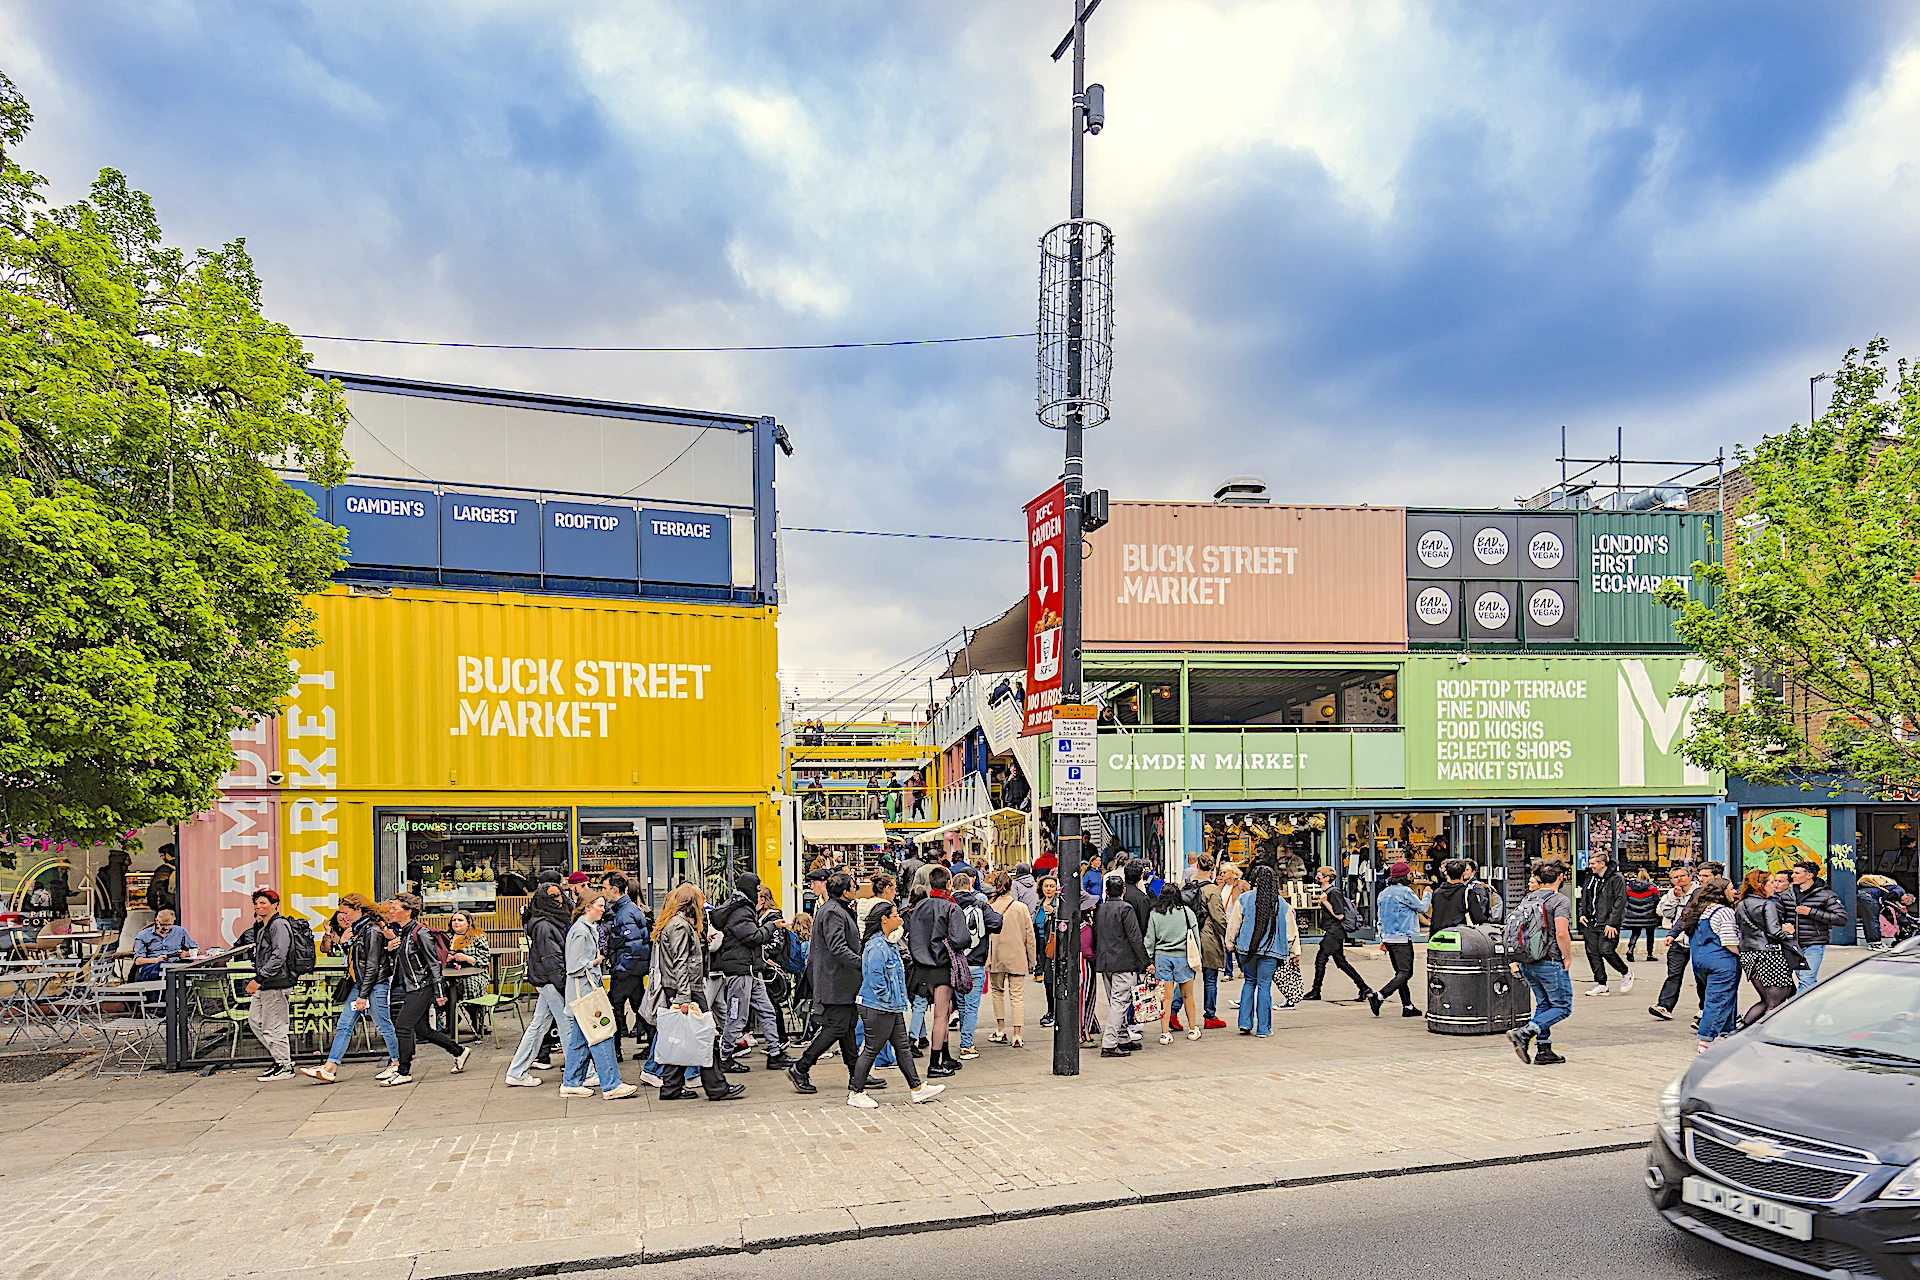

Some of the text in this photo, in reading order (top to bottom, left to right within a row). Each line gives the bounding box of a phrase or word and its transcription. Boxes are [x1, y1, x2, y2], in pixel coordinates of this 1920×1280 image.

[346, 497, 711, 539] CAMDEN'S LARGEST ROOFTOP TERRACE
[1036, 501, 1053, 523] KFC
[1032, 515, 1061, 548] CAMDEN
[1421, 539, 1444, 551] BAD
[1477, 536, 1500, 548] BAD
[1477, 547, 1505, 555] VEGAN
[1532, 540, 1555, 552] BAD
[1591, 534, 1669, 554] LONDON'S
[1122, 544, 1298, 575] BUCK STREET
[1421, 550, 1449, 558] VEGAN
[1532, 551, 1560, 559] VEGAN
[1591, 554, 1636, 573] FIRST
[1420, 595, 1442, 607] BAD
[1478, 600, 1500, 612] BAD
[1532, 597, 1555, 609] BAD
[1420, 606, 1448, 615] VEGAN
[1478, 611, 1506, 619] VEGAN
[1532, 608, 1560, 616] VEGAN
[458, 656, 711, 700] BUCK STREET
[1040, 663, 1053, 675] KFC
[1437, 680, 1587, 699] ROOFTOP TERRACE
[1027, 687, 1062, 711] 100 YARDS
[1437, 700, 1531, 719] FINE DINING
[1437, 720, 1544, 739] FOOD KIOSKS
[1437, 740, 1572, 760] ECLECTIC SHOPS
[1108, 752, 1309, 770] CAMDEN MARKET
[1437, 761, 1564, 780] MARKET STALLS
[287, 659, 339, 942] MARKET
[455, 822, 499, 831] COFFEES
[508, 822, 563, 831] SMOOTHIES
